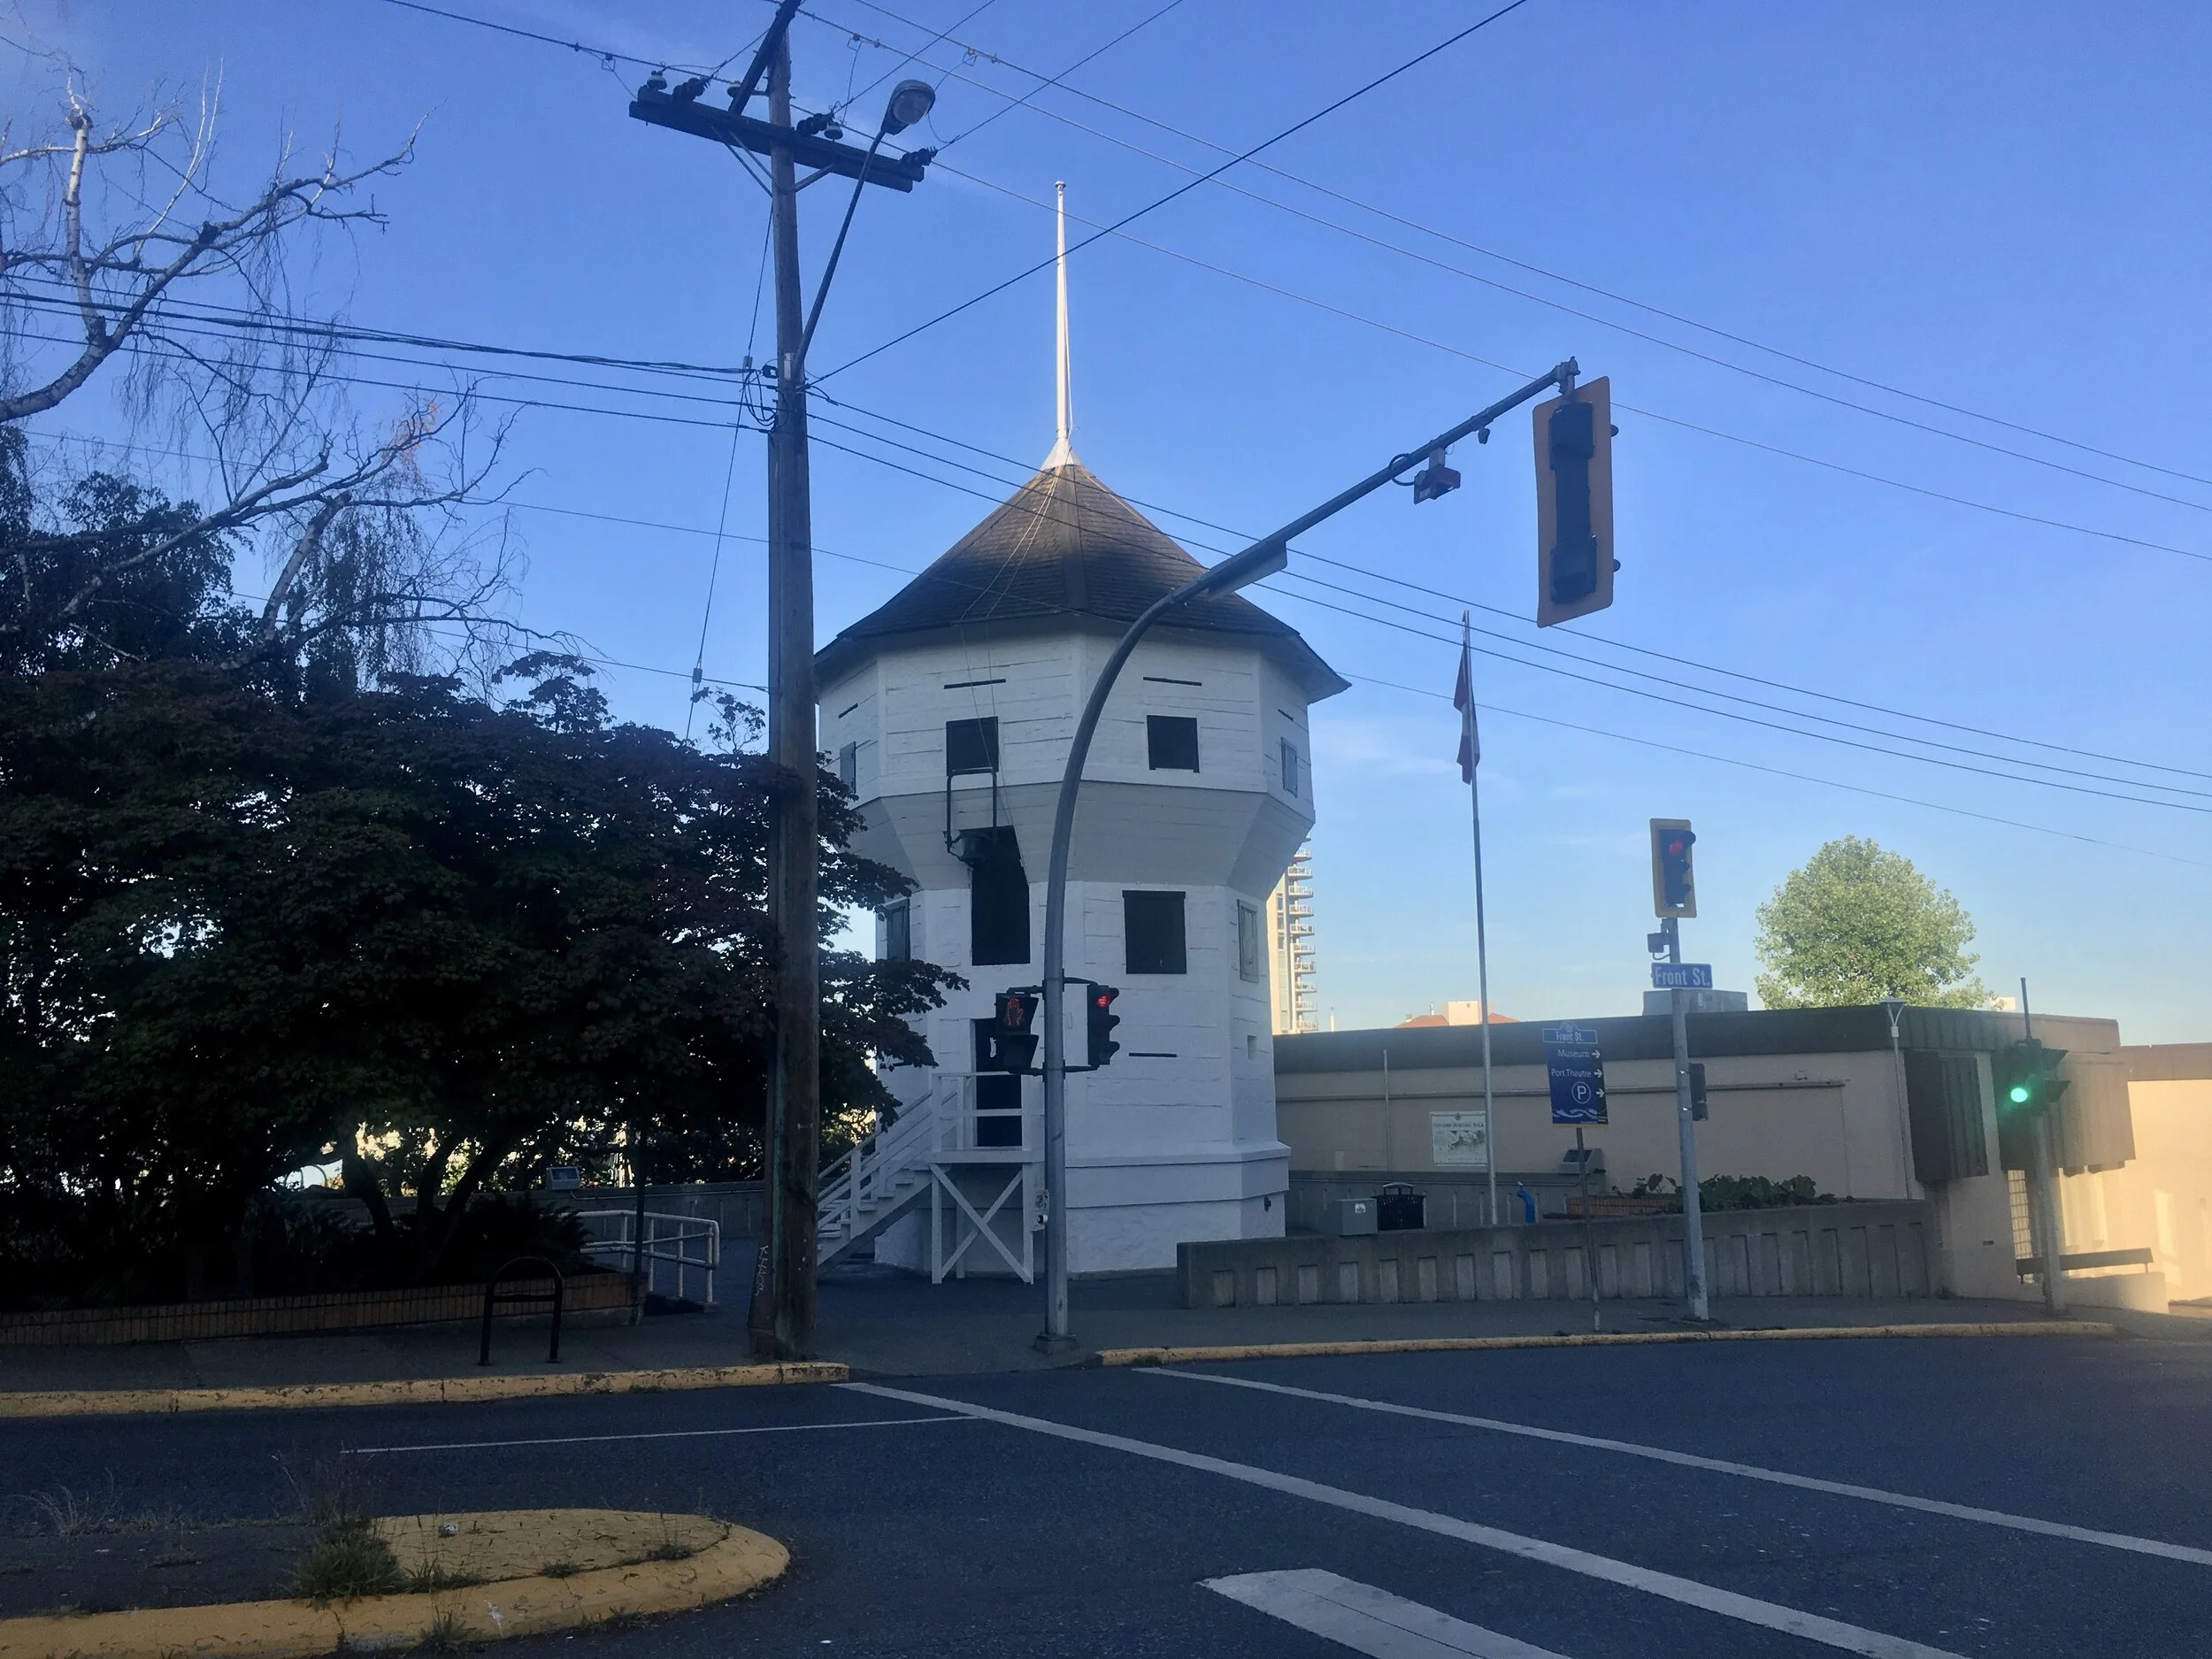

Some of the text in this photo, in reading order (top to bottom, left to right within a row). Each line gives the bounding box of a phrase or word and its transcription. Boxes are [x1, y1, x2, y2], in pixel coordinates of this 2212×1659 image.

[1655, 966, 1710, 987] Front St.
[1555, 1031, 1585, 1041] Front St.
[1557, 1049, 1590, 1058] Museum
[1577, 1086, 1586, 1100] P
